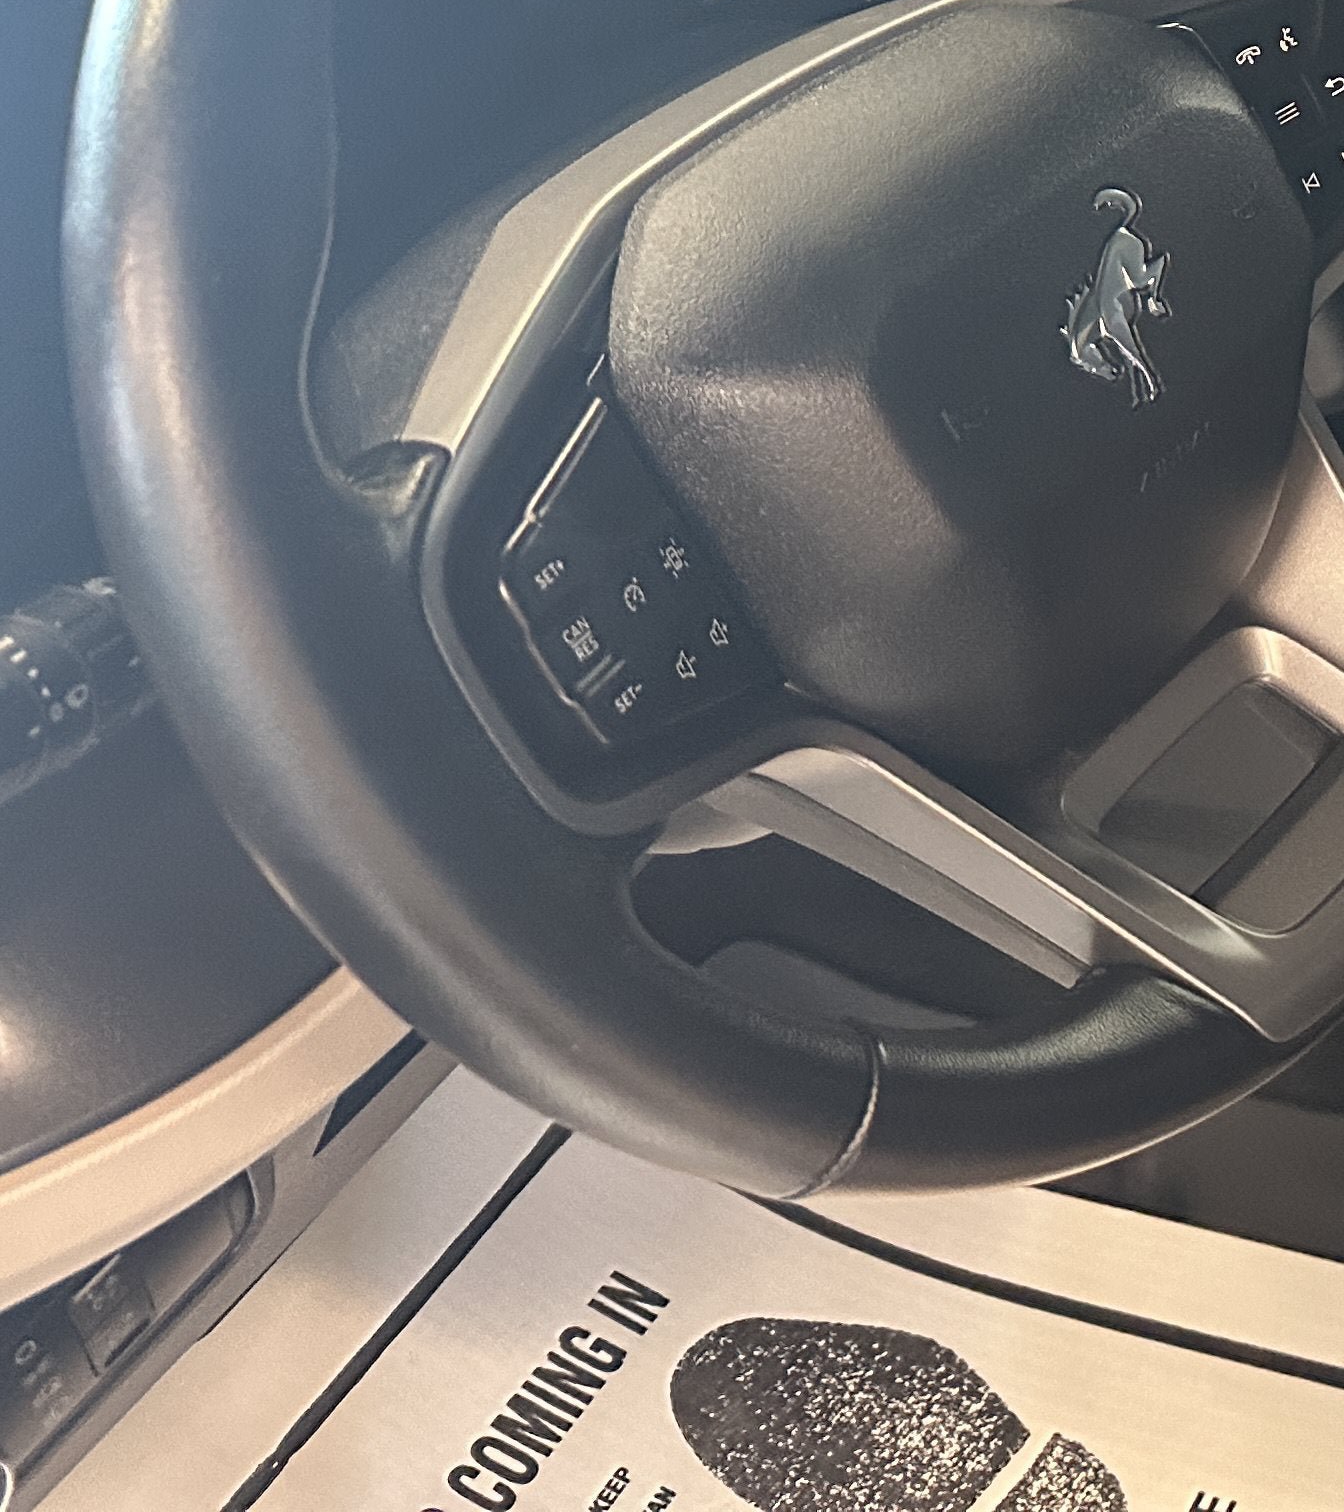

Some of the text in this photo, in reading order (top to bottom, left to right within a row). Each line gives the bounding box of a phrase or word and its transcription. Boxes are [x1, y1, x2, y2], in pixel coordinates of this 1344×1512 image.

[562, 615, 590, 645] CAN
[572, 638, 600, 663] RES
[447, 1270, 670, 1512] COMING IN
[588, 1466, 630, 1512] KEEP
